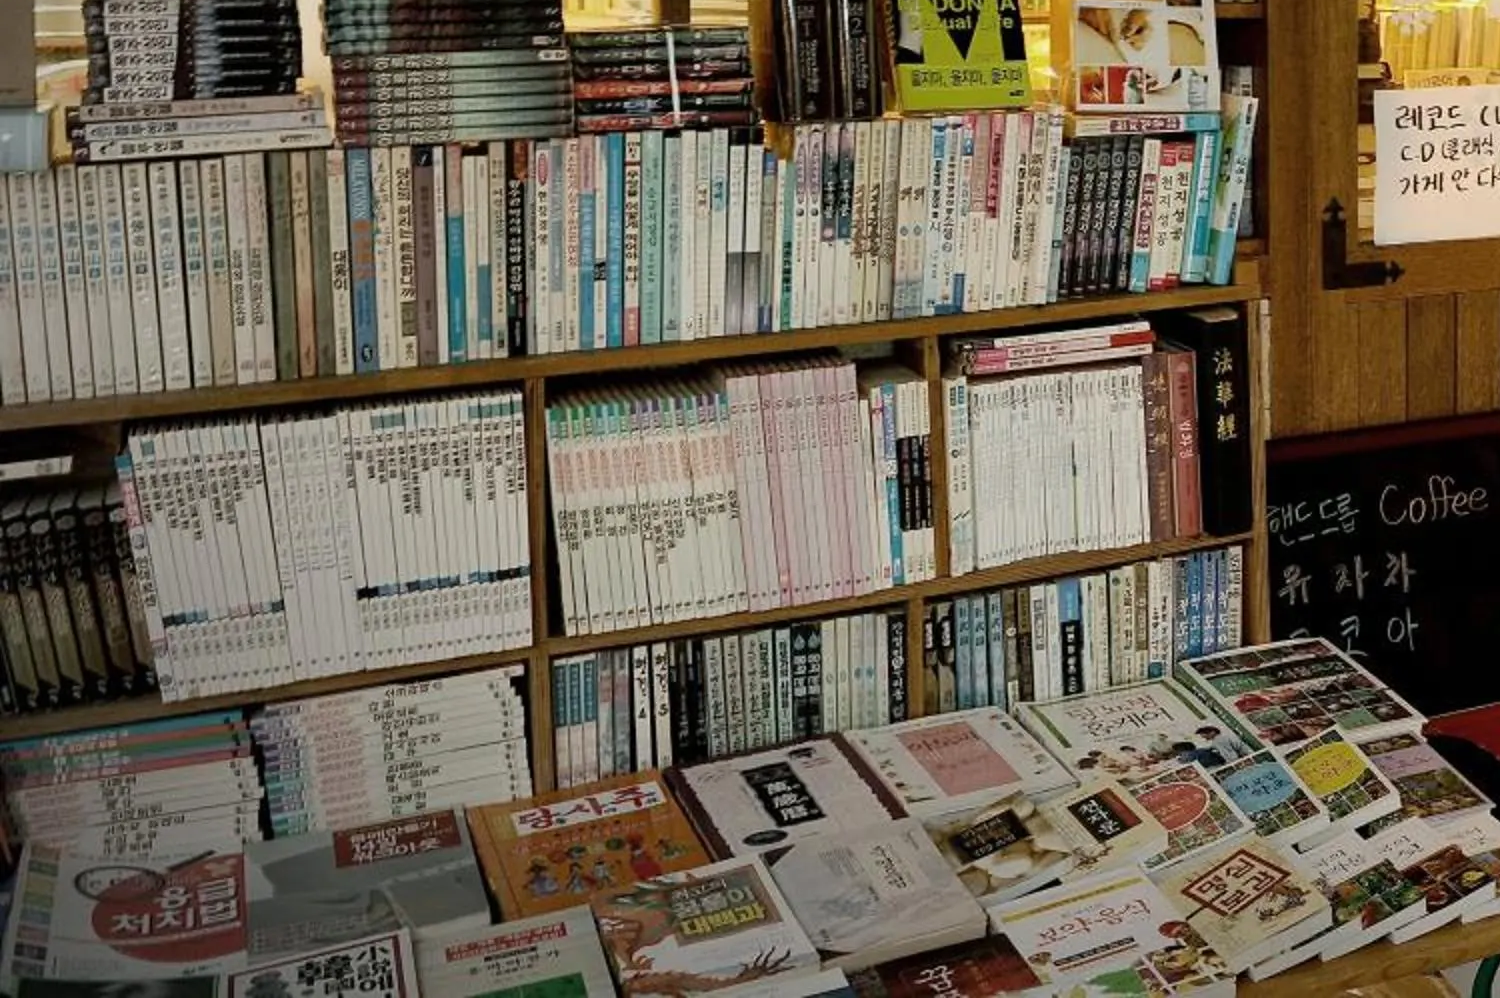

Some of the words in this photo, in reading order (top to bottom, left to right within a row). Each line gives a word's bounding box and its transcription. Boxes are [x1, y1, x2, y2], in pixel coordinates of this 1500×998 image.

[1394, 103, 1468, 132] 레코드
[1399, 167, 1445, 196] 가게
[1450, 165, 1470, 193] 안
[1213, 347, 1237, 442] 法華經
[1378, 474, 1489, 526] Coffee
